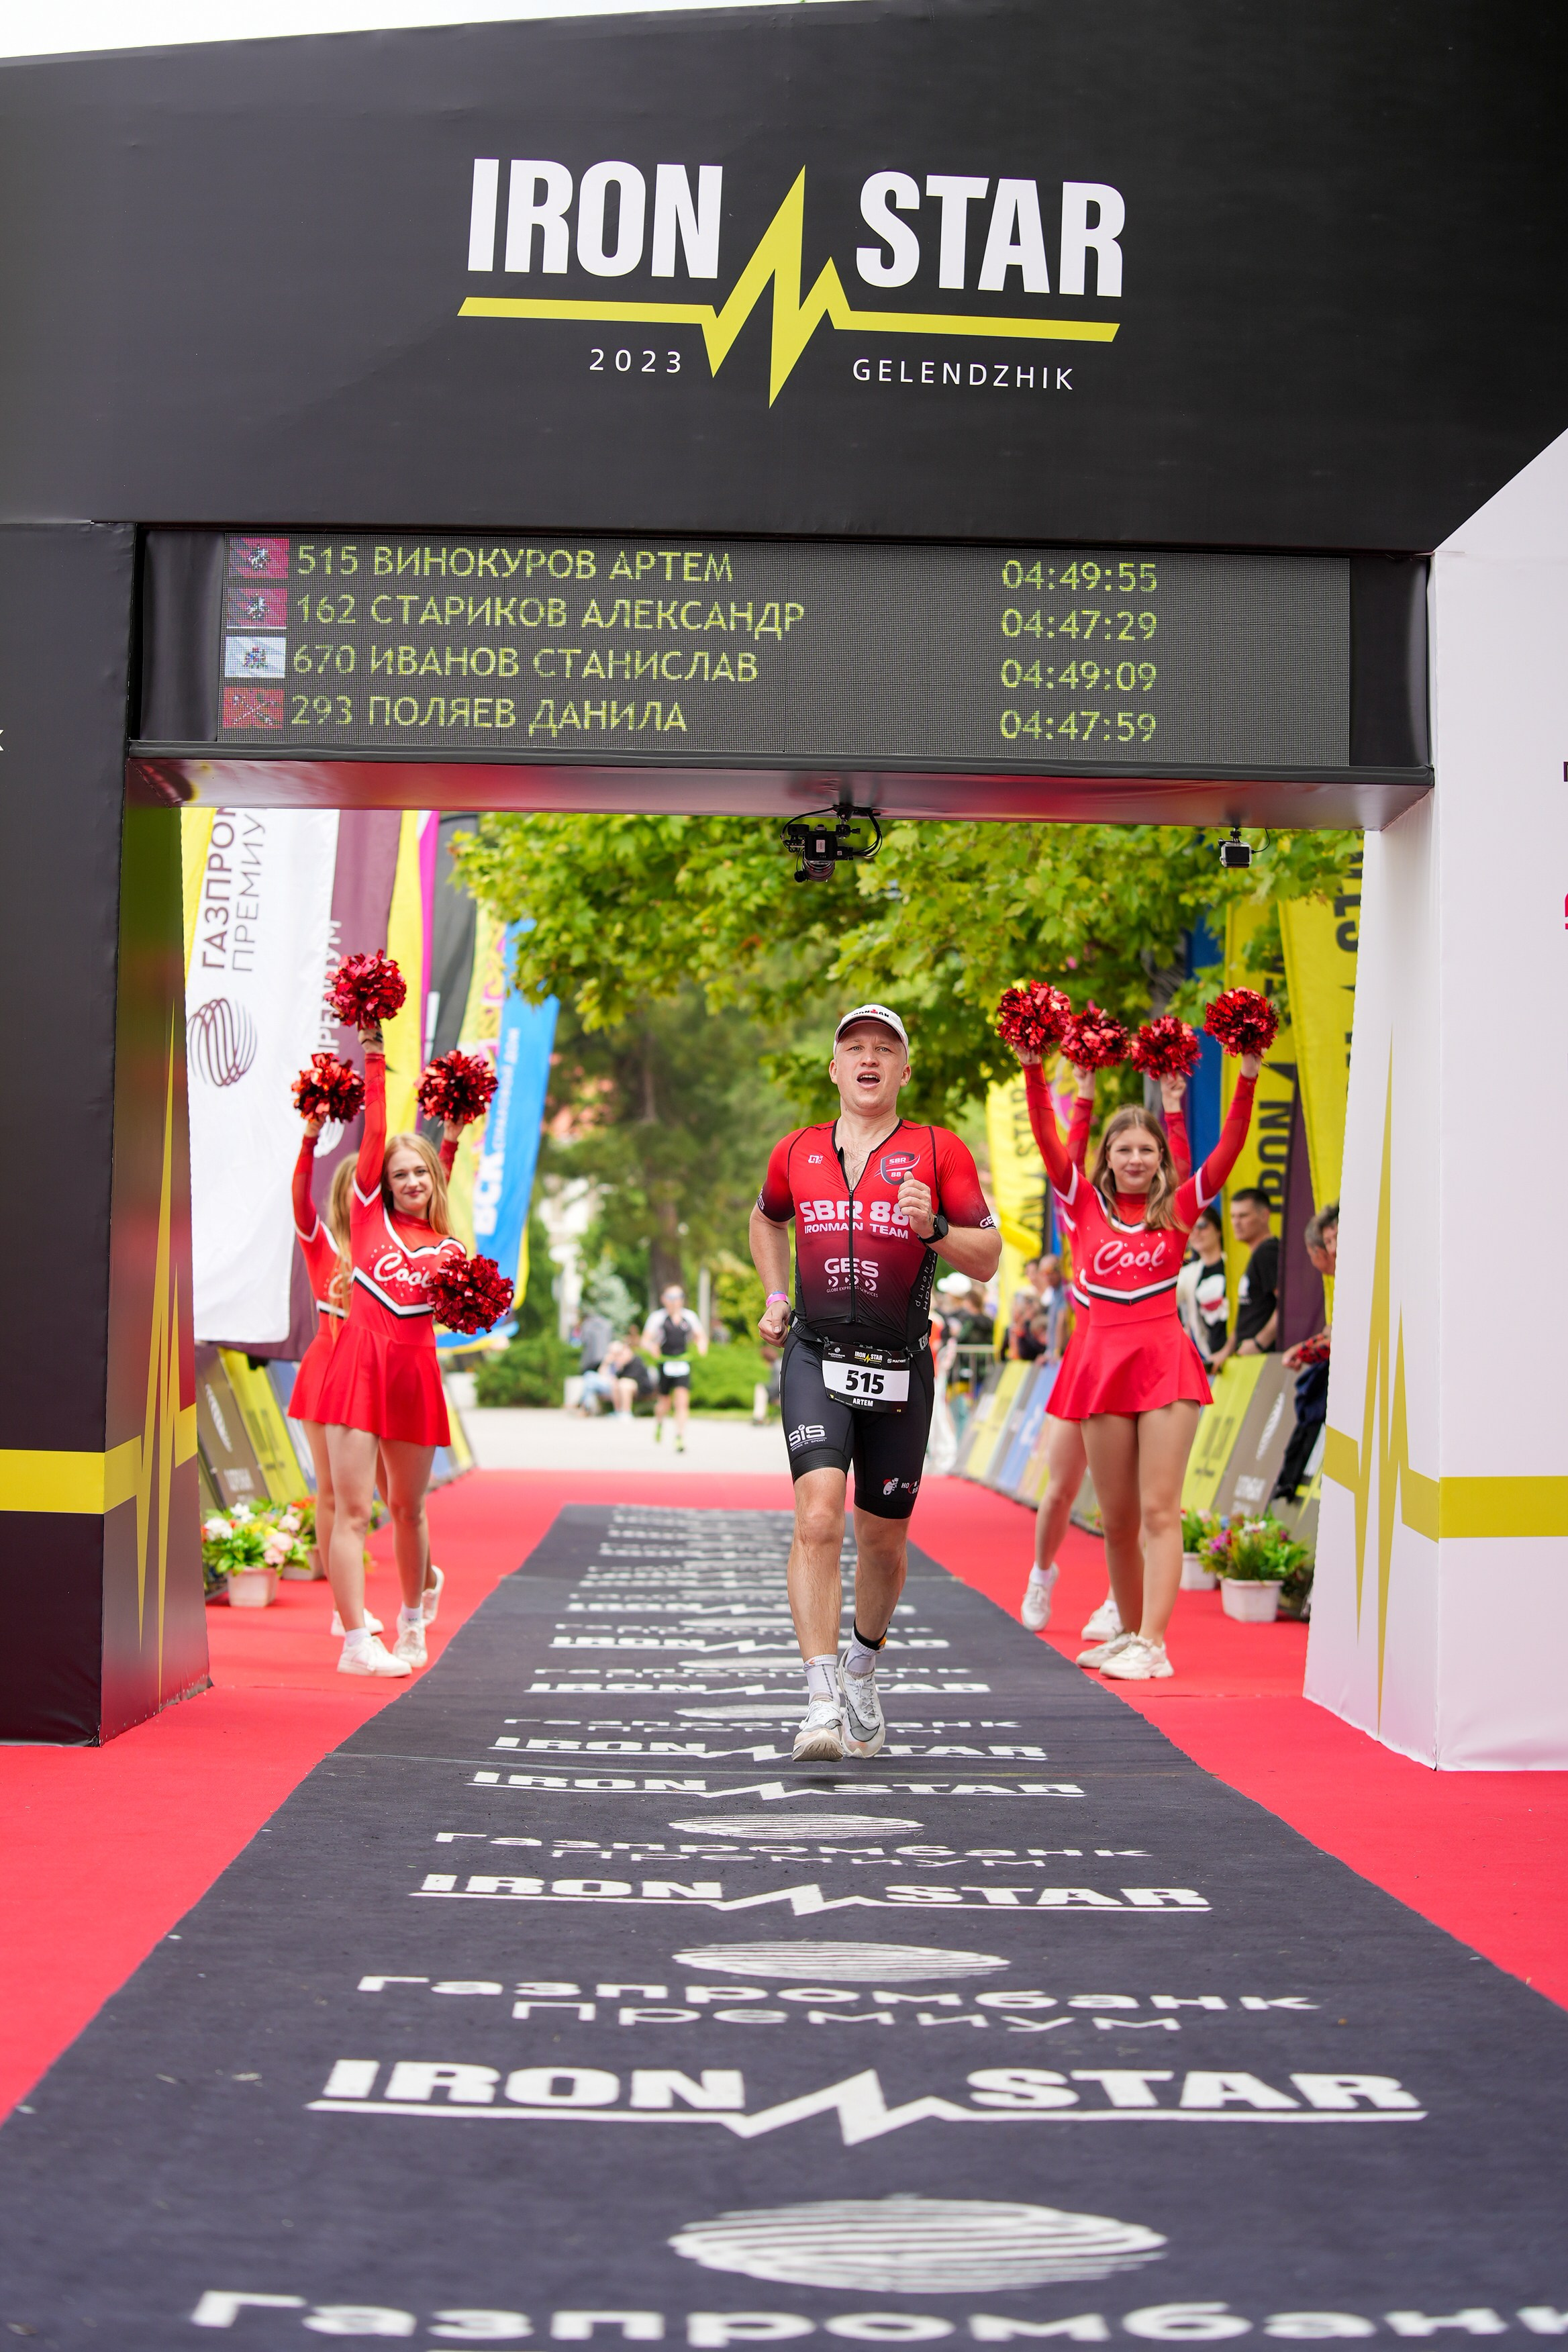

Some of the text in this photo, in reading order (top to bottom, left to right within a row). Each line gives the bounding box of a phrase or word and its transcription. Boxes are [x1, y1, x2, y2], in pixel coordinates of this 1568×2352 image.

[467, 158, 1126, 297] IRON STAR
[590, 347, 1074, 390] 2023 GELENDZHIK
[297, 546, 1157, 592] 515 ВИНОКУРОВ АРТЕМ 04:49:55
[297, 595, 1157, 640] 162 СТАРИКОВ АЛЕКСАНДР 04:47:29
[293, 646, 1157, 691] 670 ИВАНОВ СТАНИСЛАВ 04:49:09
[291, 695, 1157, 742] 293 ПОЛЯЕВ ДАНИЛА 04:47:59
[232, 808, 266, 971] ПРЕМИУ
[799, 1200, 909, 1226] SBR 88
[979, 1216, 995, 1228] GE
[805, 1222, 908, 1240] IRONMAN TEAM
[824, 1258, 879, 1278] GES
[1093, 1240, 1167, 1276] Cool
[871, 1353, 883, 1361] STAR
[846, 1369, 885, 1395] 515
[852, 1398, 873, 1407] ARTEM
[495, 1736, 1048, 1757] IRON TAR
[474, 1771, 1085, 1794] IRON STAR
[436, 1832, 1153, 1857] Газпромбанк
[551, 1850, 1046, 1867] Премиум
[421, 1874, 1210, 1906] IRON STAR
[357, 1976, 1320, 2010] Газпромбанк
[511, 2001, 1181, 2032] Премиум
[323, 2059, 1422, 2109] IRON STAR
